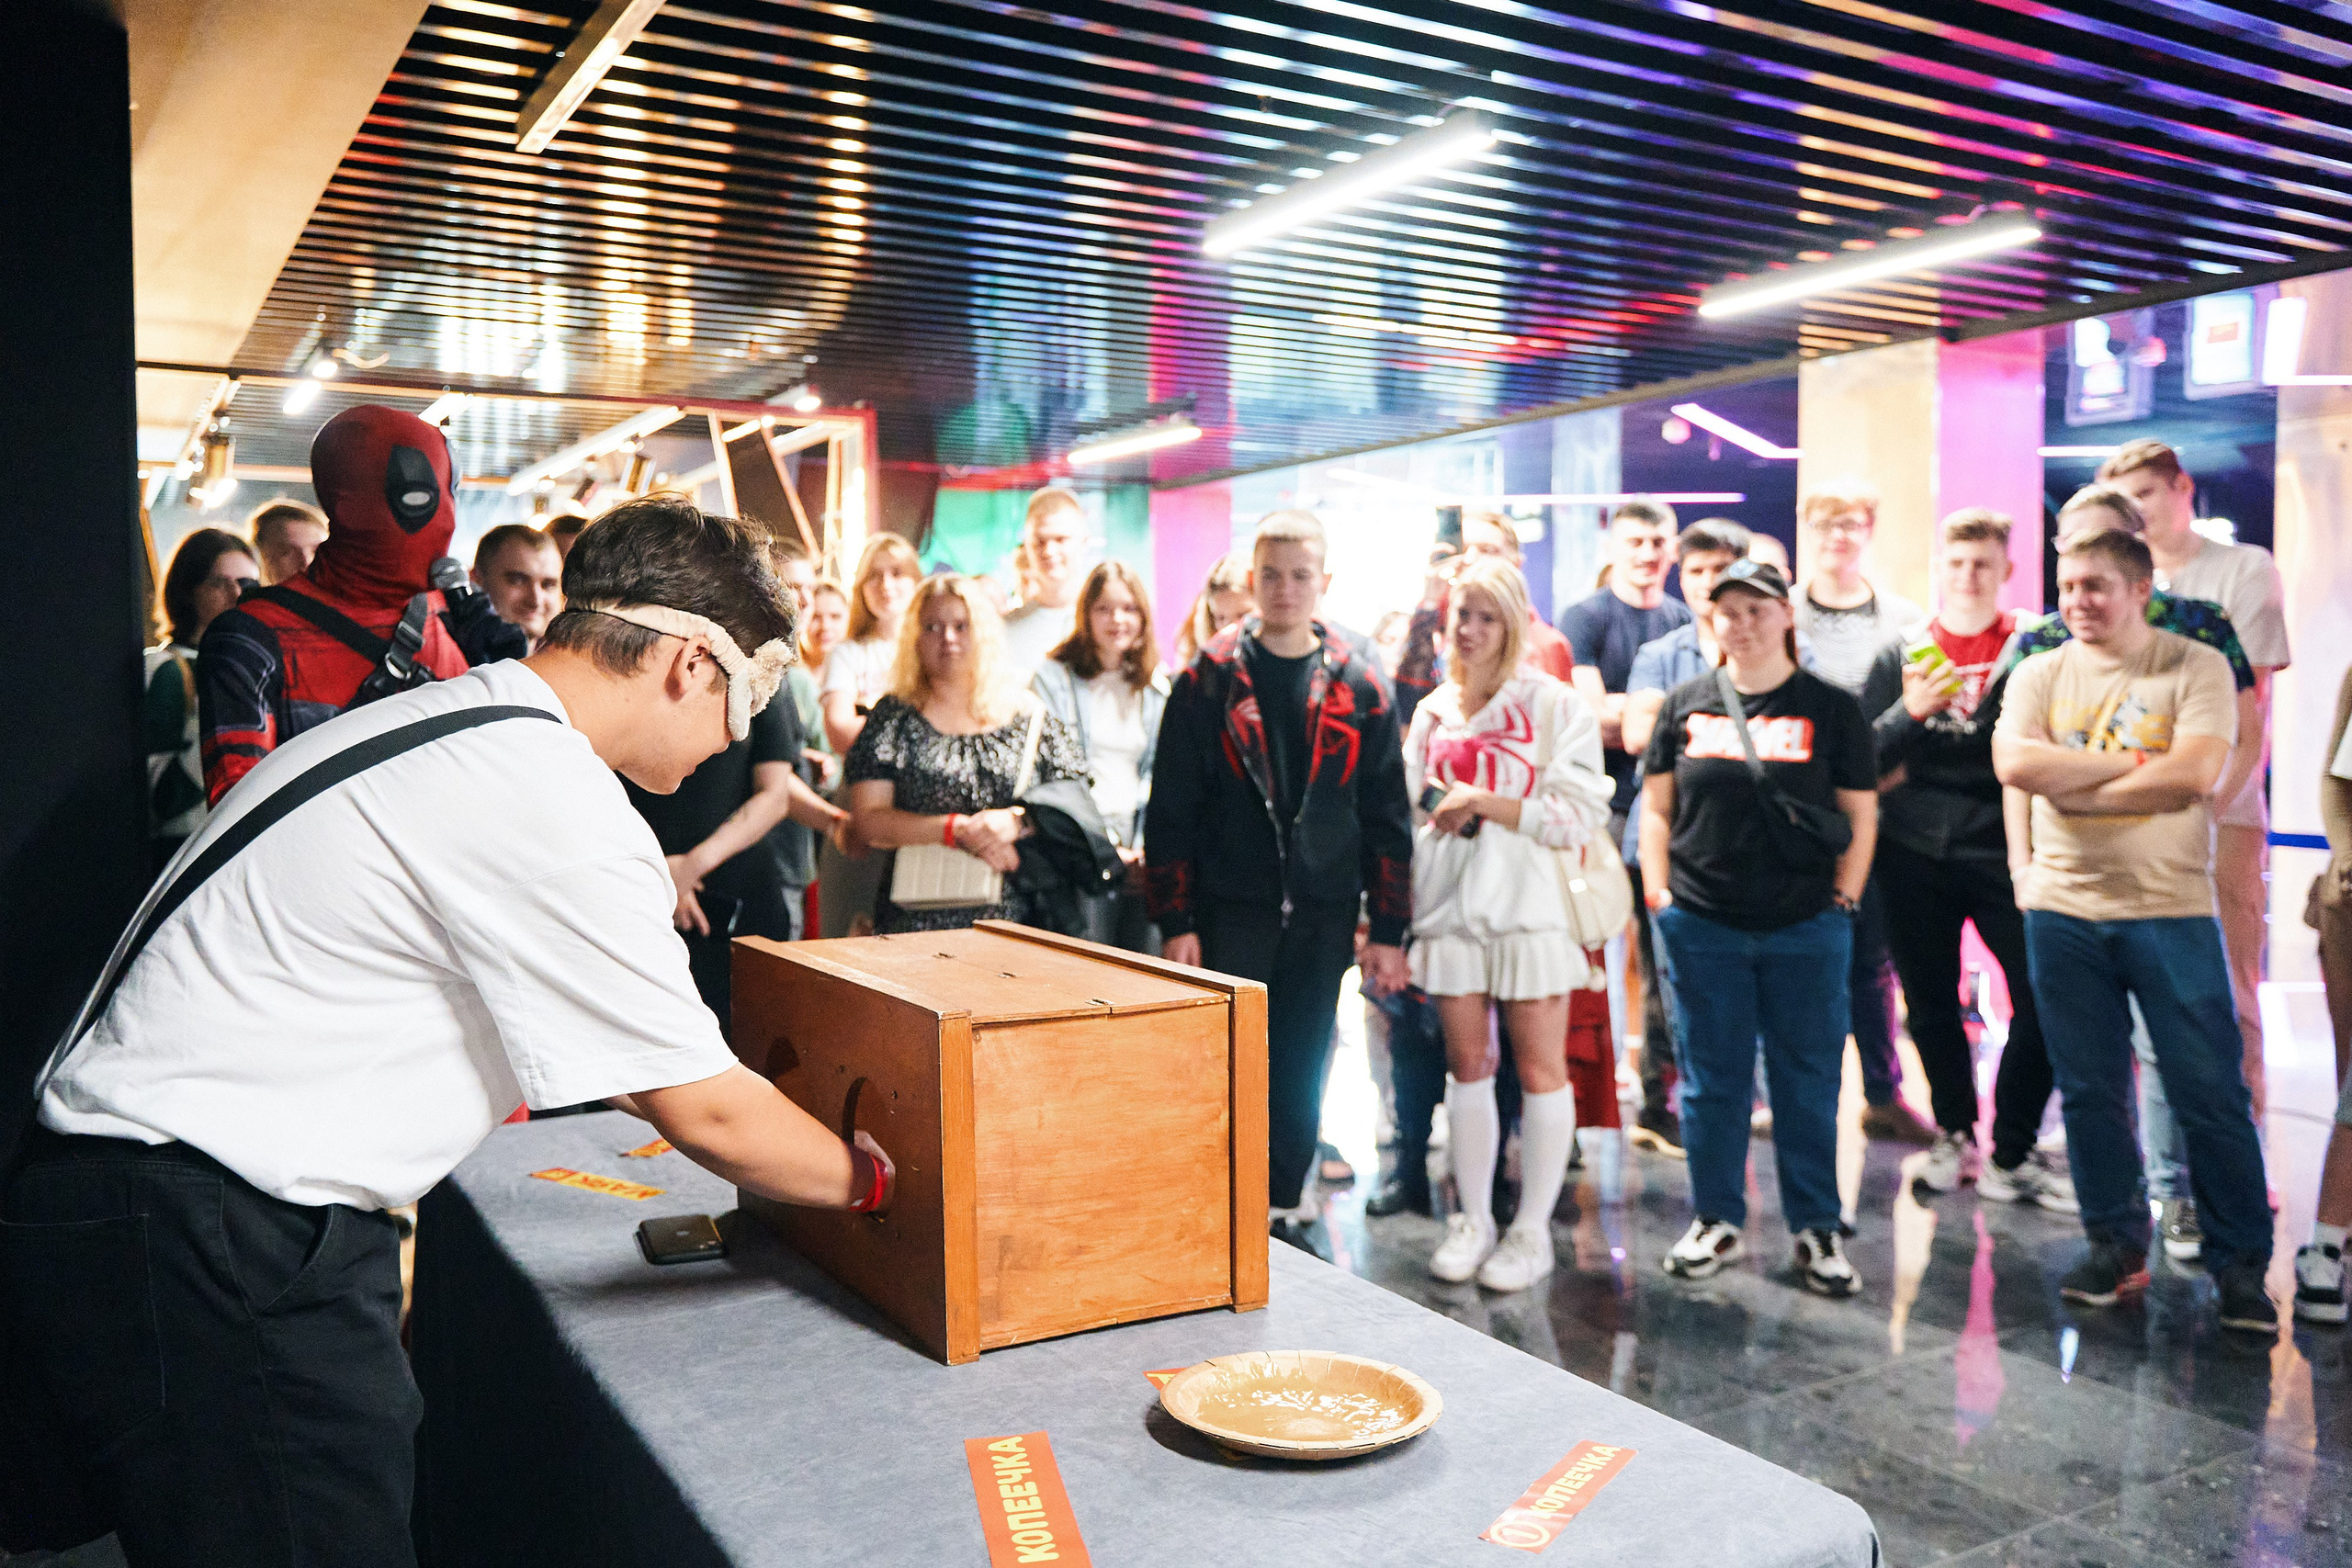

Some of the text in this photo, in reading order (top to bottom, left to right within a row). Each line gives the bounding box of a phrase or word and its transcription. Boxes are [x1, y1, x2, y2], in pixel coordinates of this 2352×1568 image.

[1685, 713, 1814, 761] MAVEL
[988, 1436, 1059, 1563] КОПЕЕЧКА
[1529, 1445, 1622, 1520] КОПЕЕЧКА
